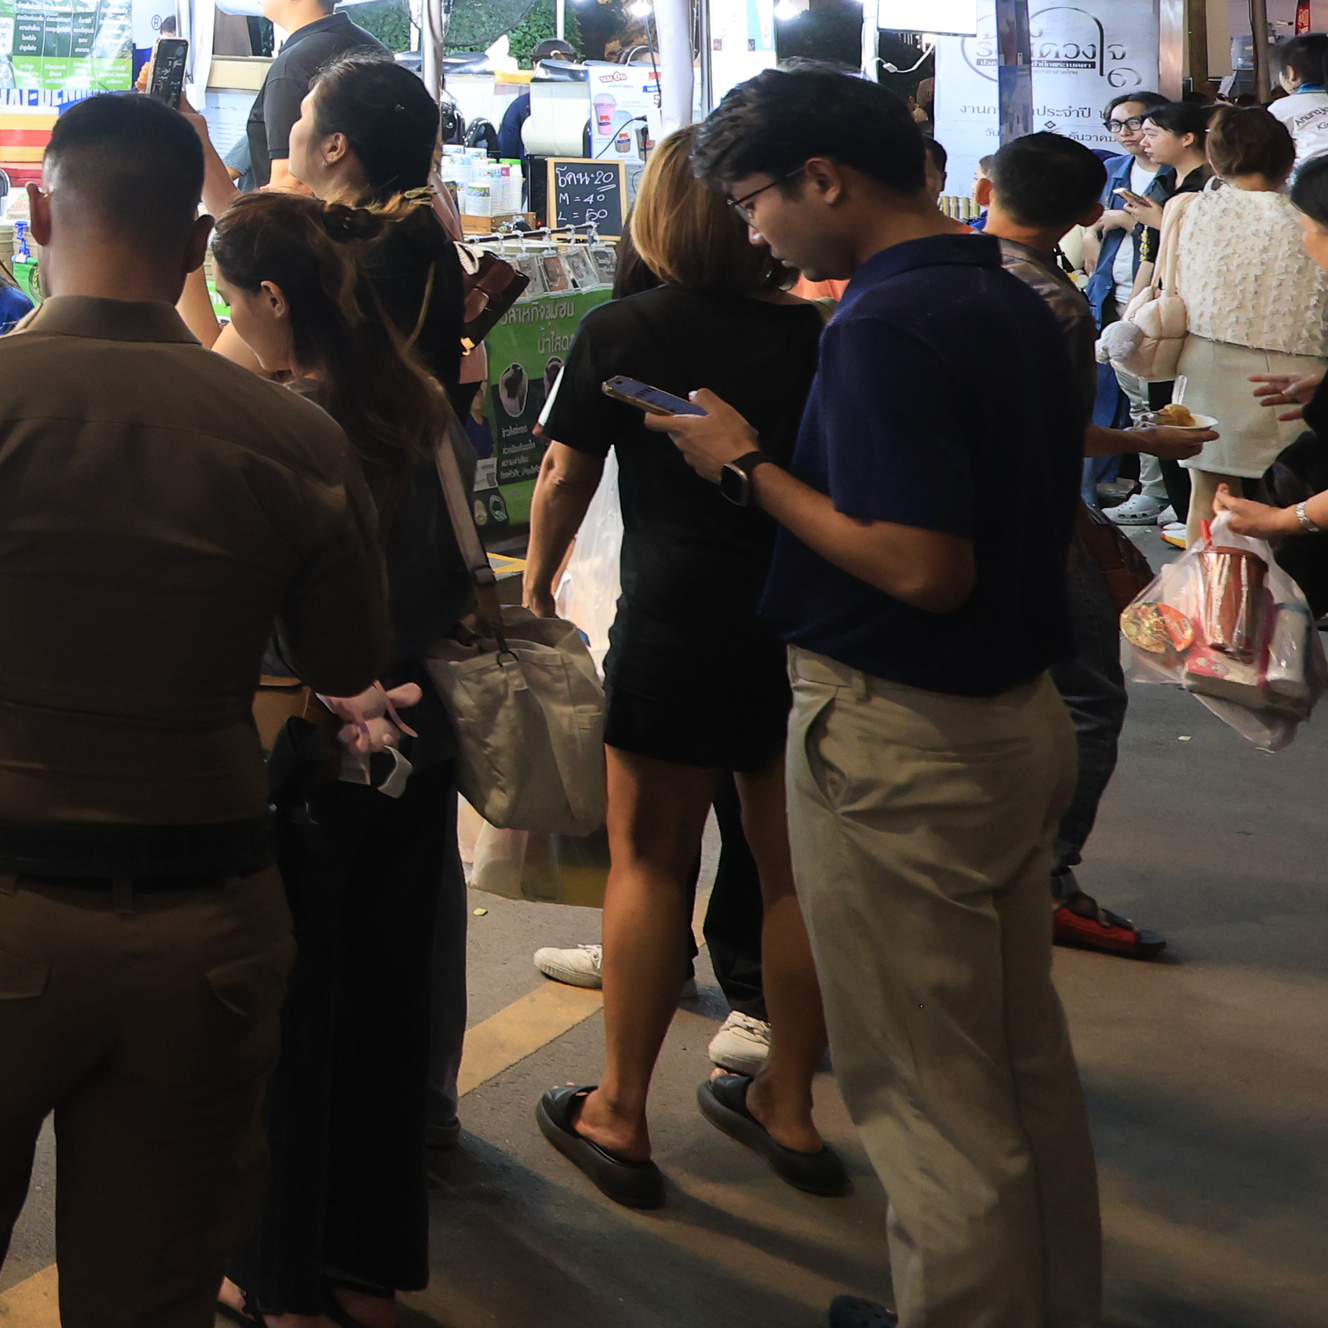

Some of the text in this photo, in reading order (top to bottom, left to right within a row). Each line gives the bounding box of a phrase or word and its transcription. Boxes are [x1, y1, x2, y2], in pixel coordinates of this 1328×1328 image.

[559, 192, 569, 205] M
[583, 194, 605, 205] 40
[557, 211, 567, 221] L
